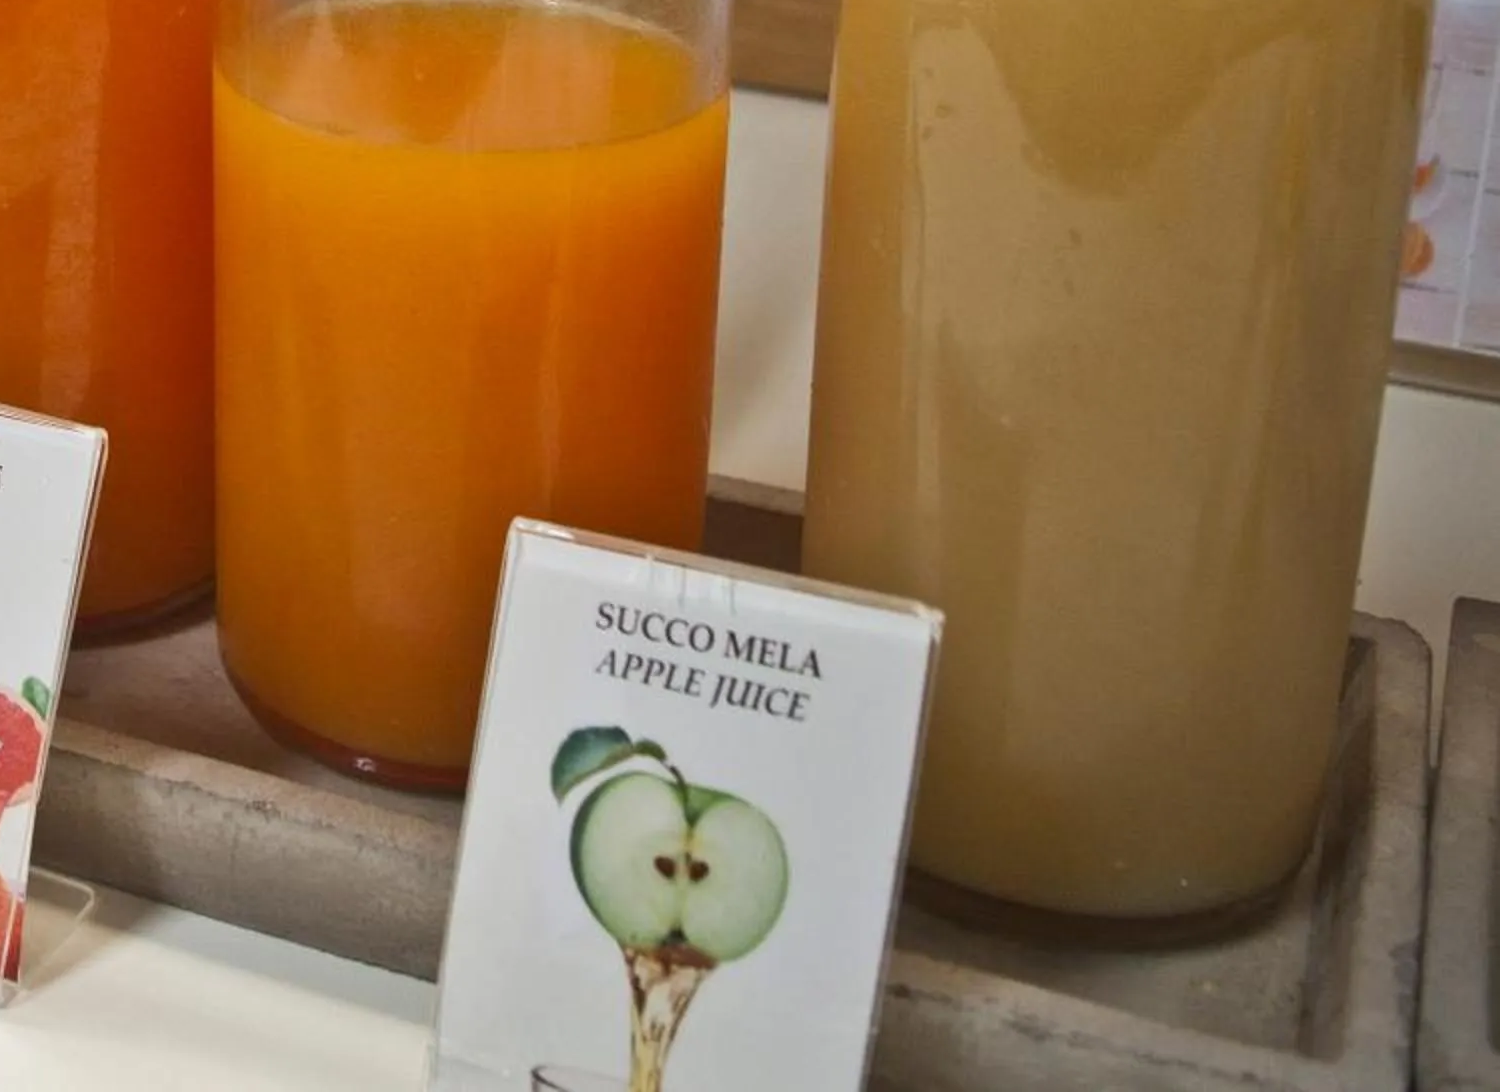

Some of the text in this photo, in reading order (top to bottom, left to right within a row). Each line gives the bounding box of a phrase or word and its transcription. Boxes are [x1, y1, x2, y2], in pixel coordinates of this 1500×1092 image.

[595, 602, 822, 679] SUCCO MELA
[595, 649, 811, 722] APPLE JUICE
